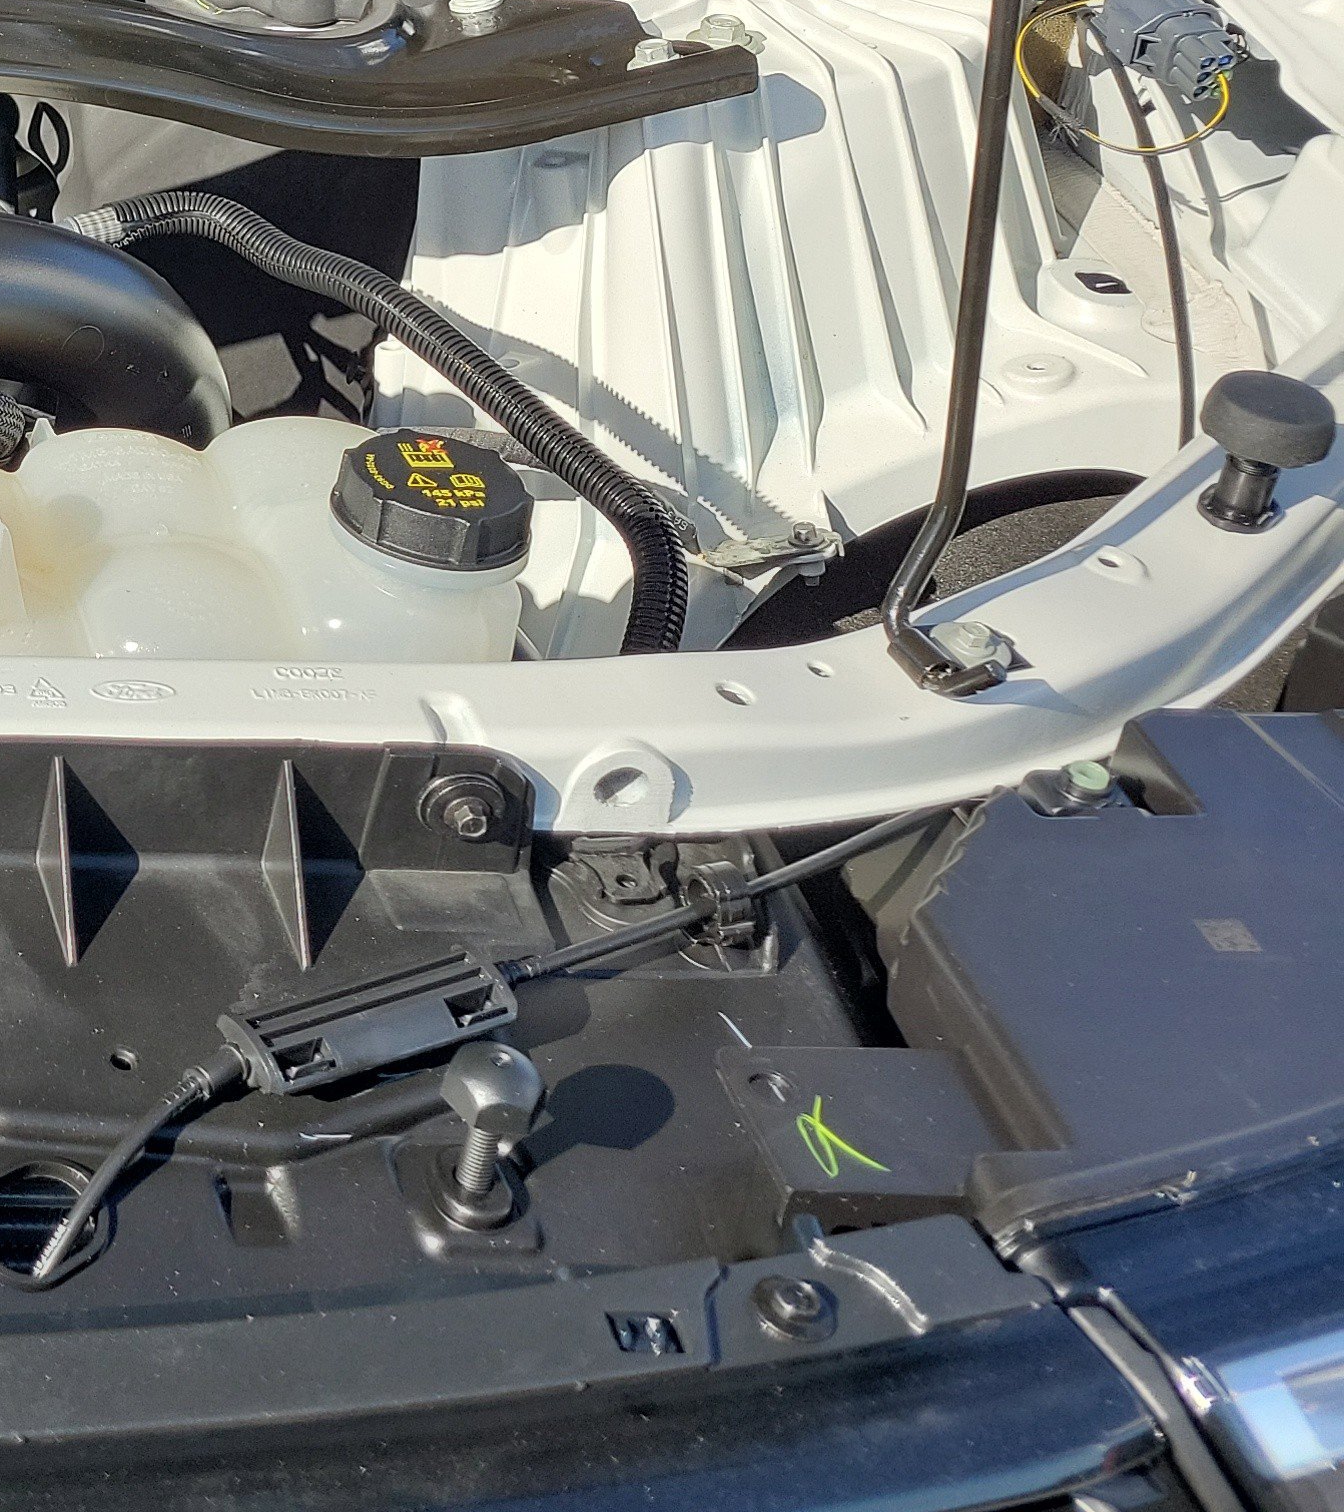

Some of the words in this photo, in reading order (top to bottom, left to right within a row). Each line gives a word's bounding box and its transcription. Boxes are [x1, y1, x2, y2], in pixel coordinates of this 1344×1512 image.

[421, 489, 452, 497] 145
[453, 489, 486, 497] kPa
[435, 498, 457, 507] 21
[459, 498, 485, 508] psi
